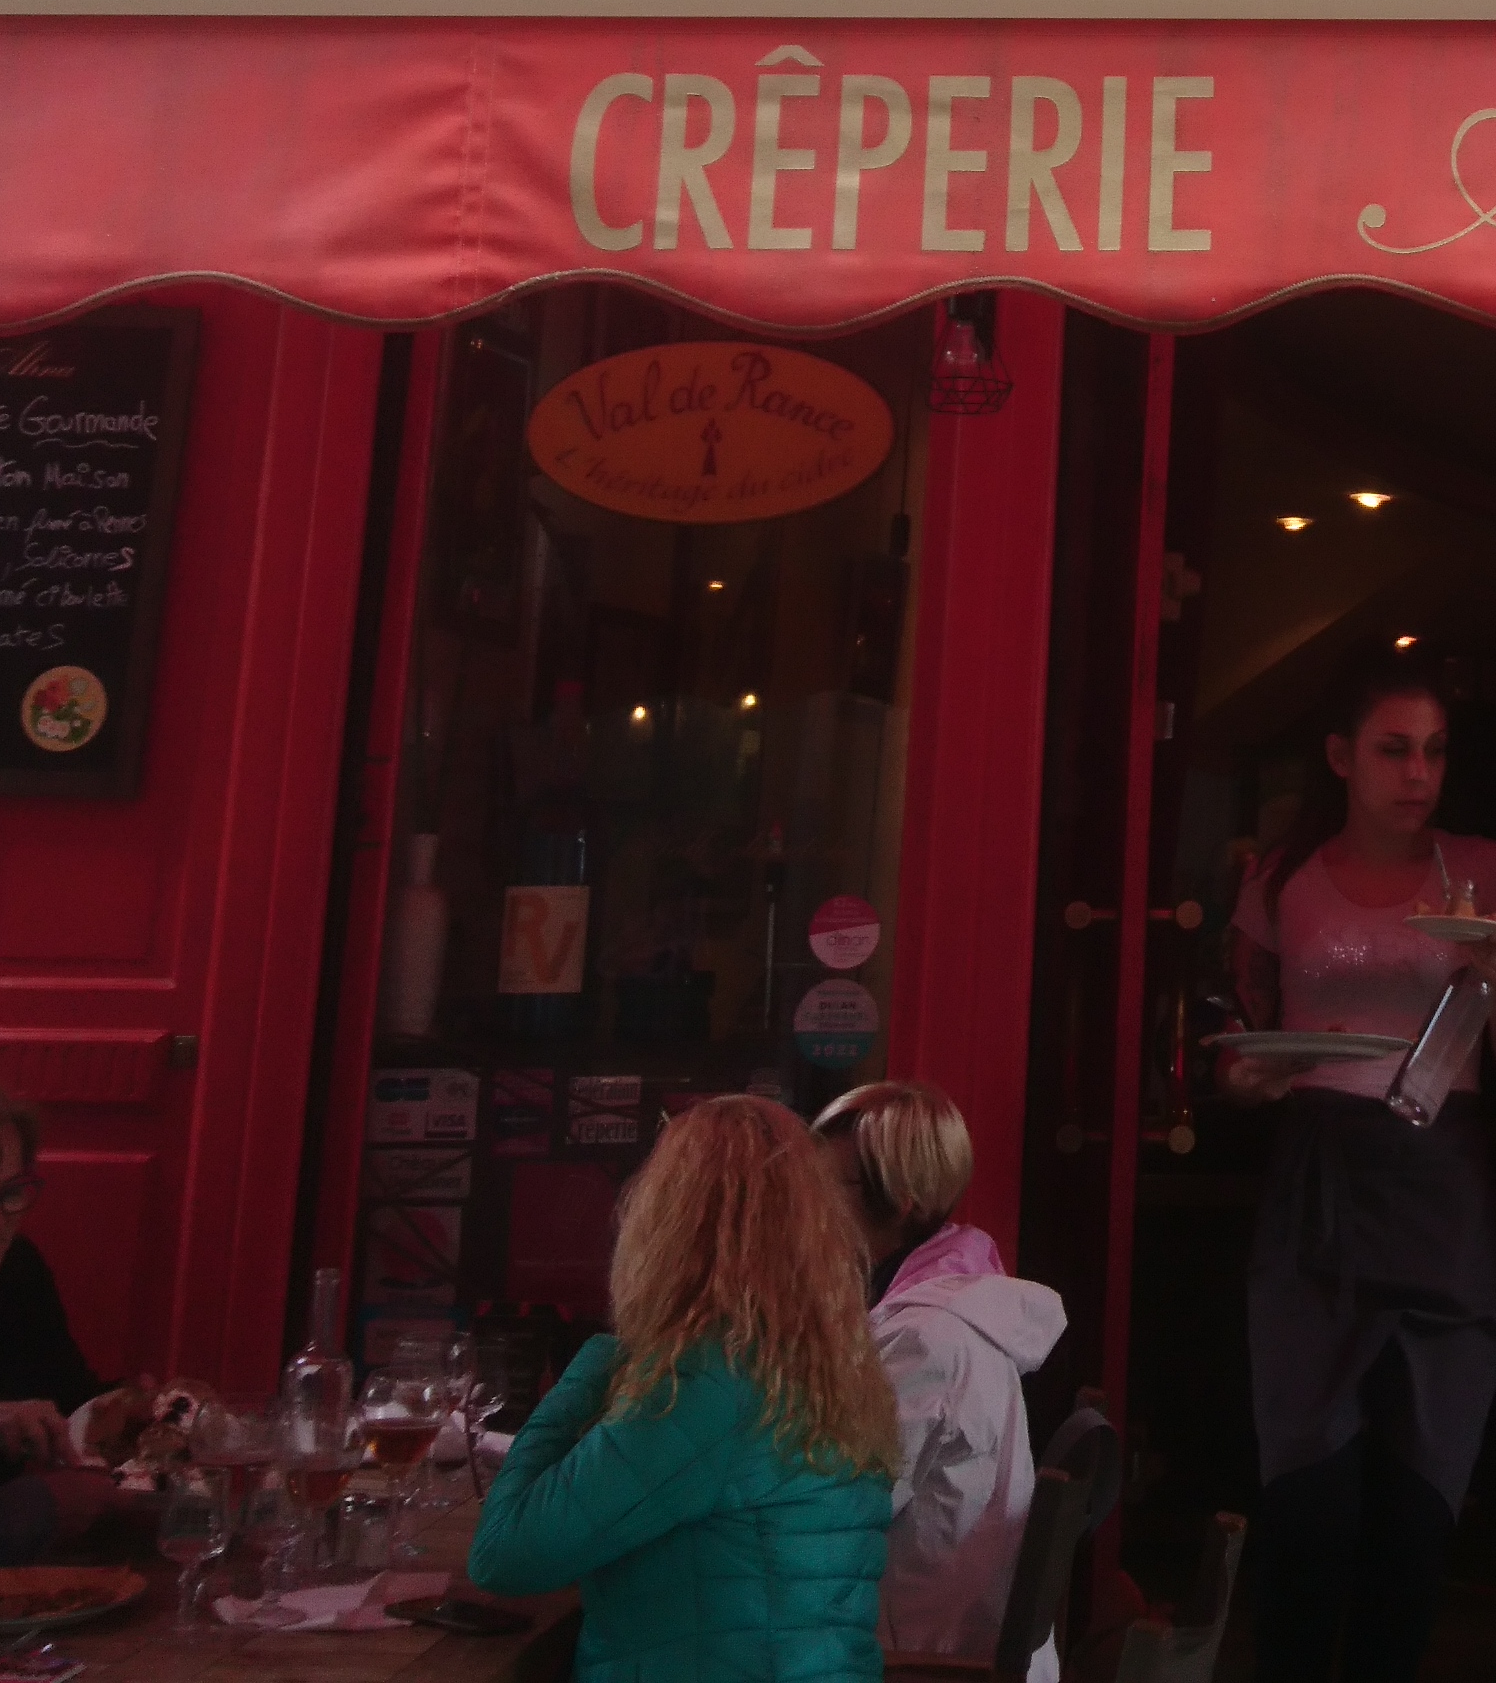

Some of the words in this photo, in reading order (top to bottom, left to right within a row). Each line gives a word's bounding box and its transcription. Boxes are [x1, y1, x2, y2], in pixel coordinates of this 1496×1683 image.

[568, 44, 1215, 253] CRÊPERIE
[18, 394, 160, 442] Gourmande
[568, 359, 658, 443] Val
[668, 365, 717, 416] de
[724, 350, 856, 441] Rance
[42, 461, 131, 491] Maison
